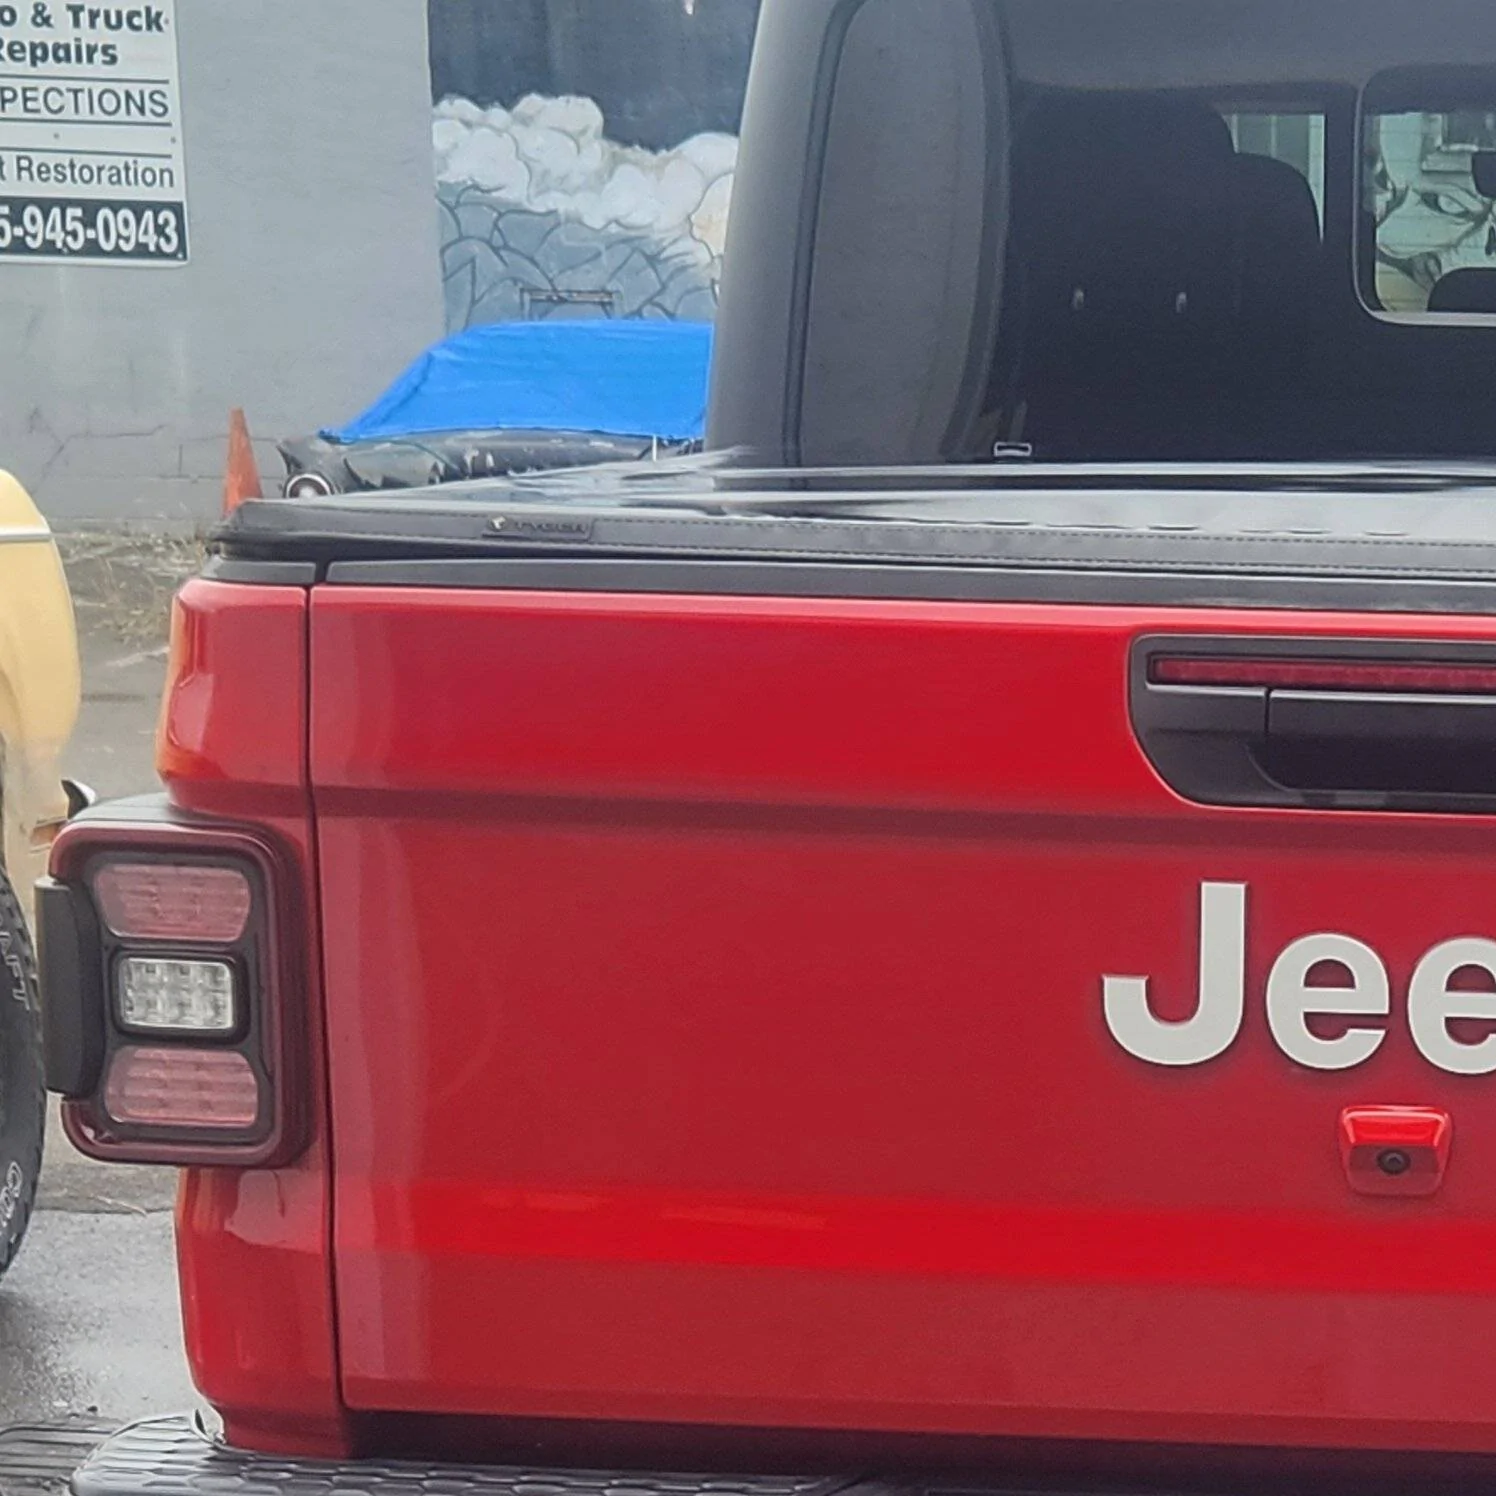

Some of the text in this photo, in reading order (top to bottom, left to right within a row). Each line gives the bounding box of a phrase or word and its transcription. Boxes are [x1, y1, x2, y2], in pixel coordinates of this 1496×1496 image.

[30, 2, 54, 29] &
[66, 4, 164, 33] Truck
[0, 37, 118, 68] epairs
[0, 86, 169, 118] PECTIONS
[16, 155, 174, 188] Restoration
[0, 204, 179, 253] 5-945-0943
